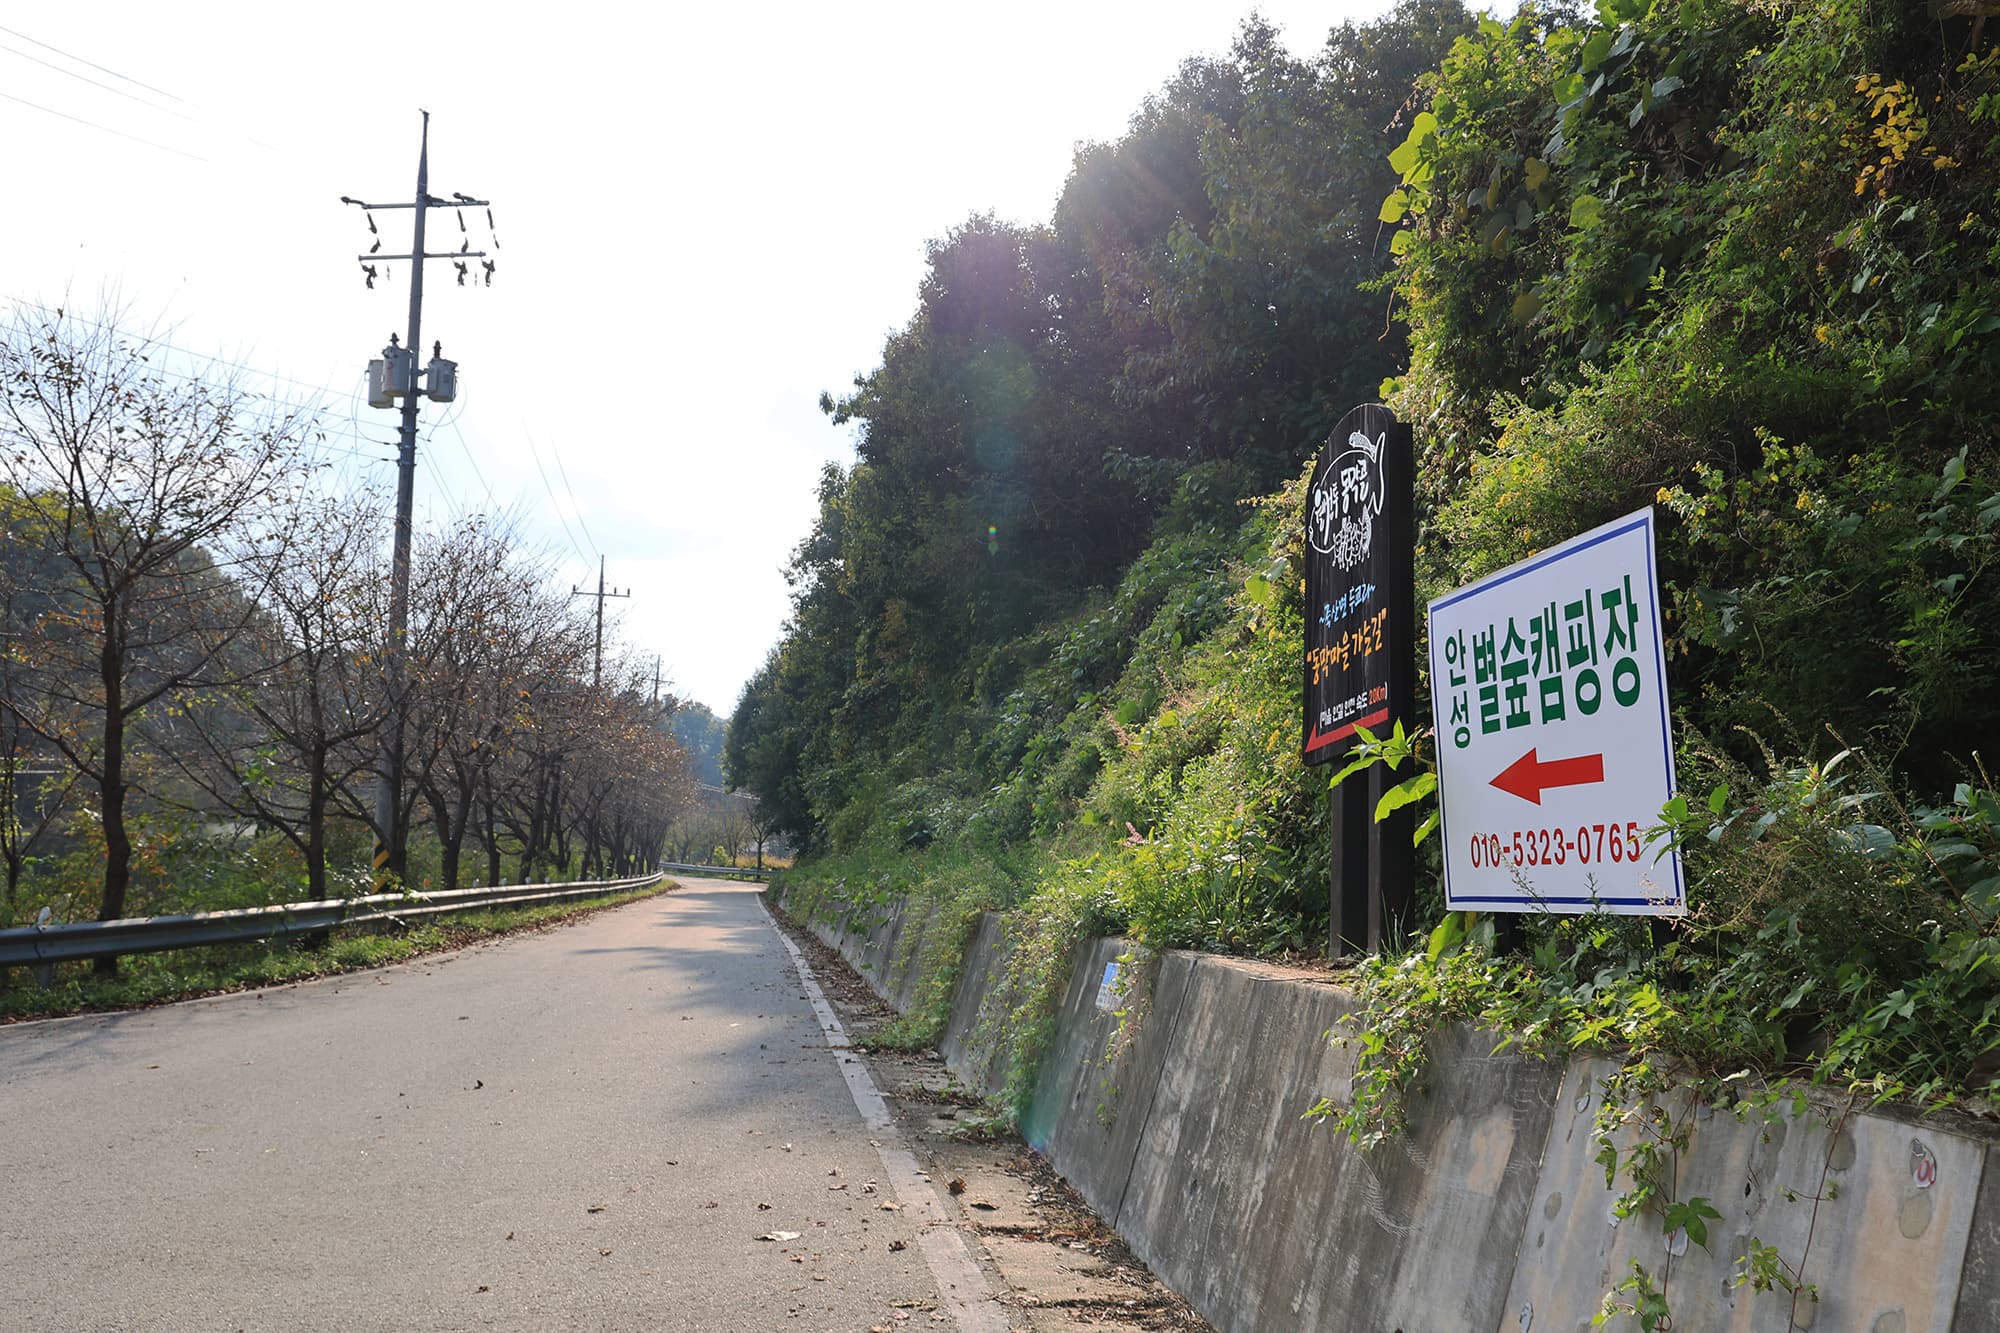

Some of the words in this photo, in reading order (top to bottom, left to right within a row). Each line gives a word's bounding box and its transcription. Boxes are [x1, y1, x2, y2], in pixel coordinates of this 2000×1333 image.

[1445, 629, 1471, 749] 안성
[1473, 574, 1641, 735] 별숲캠핑장
[1471, 822, 1640, 869] 010-5323-0765
